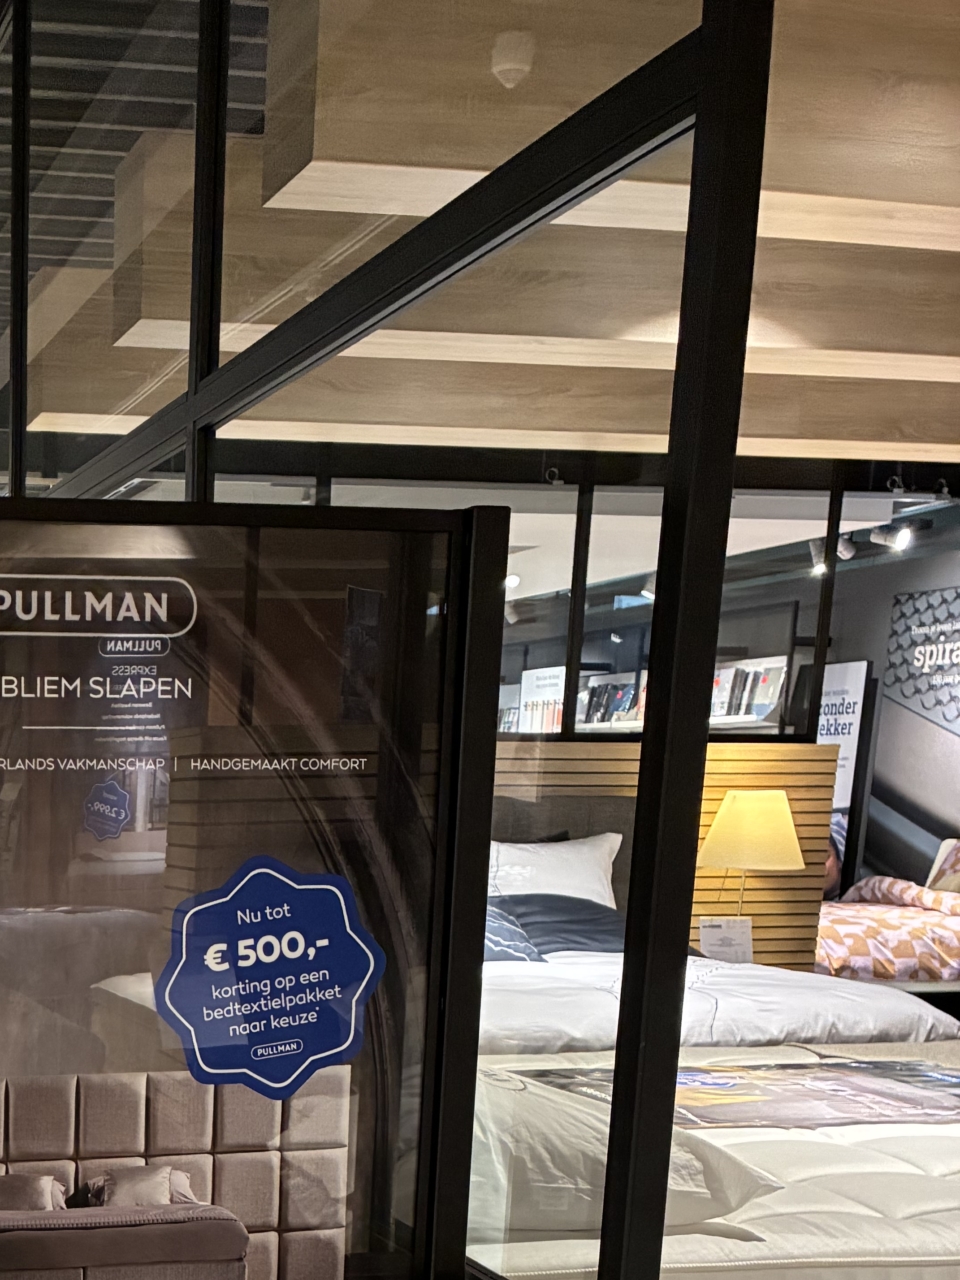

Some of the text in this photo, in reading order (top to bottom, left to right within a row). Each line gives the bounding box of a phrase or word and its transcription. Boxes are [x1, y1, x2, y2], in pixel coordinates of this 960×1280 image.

[89, 676, 192, 699] SLAPEN
[818, 718, 854, 737] ekker
[57, 758, 165, 771] VAKMANSCHAP
[190, 758, 298, 771] HANDGEMAAKT
[299, 758, 368, 771] COMFORT
[237, 903, 291, 925] Nu tot
[203, 930, 329, 972] € 500,-
[212, 969, 329, 1000] korting op een
[203, 984, 342, 1022] bedtextielpakket
[229, 1020, 267, 1037] naar
[257, 1042, 298, 1057] PULLMAN
